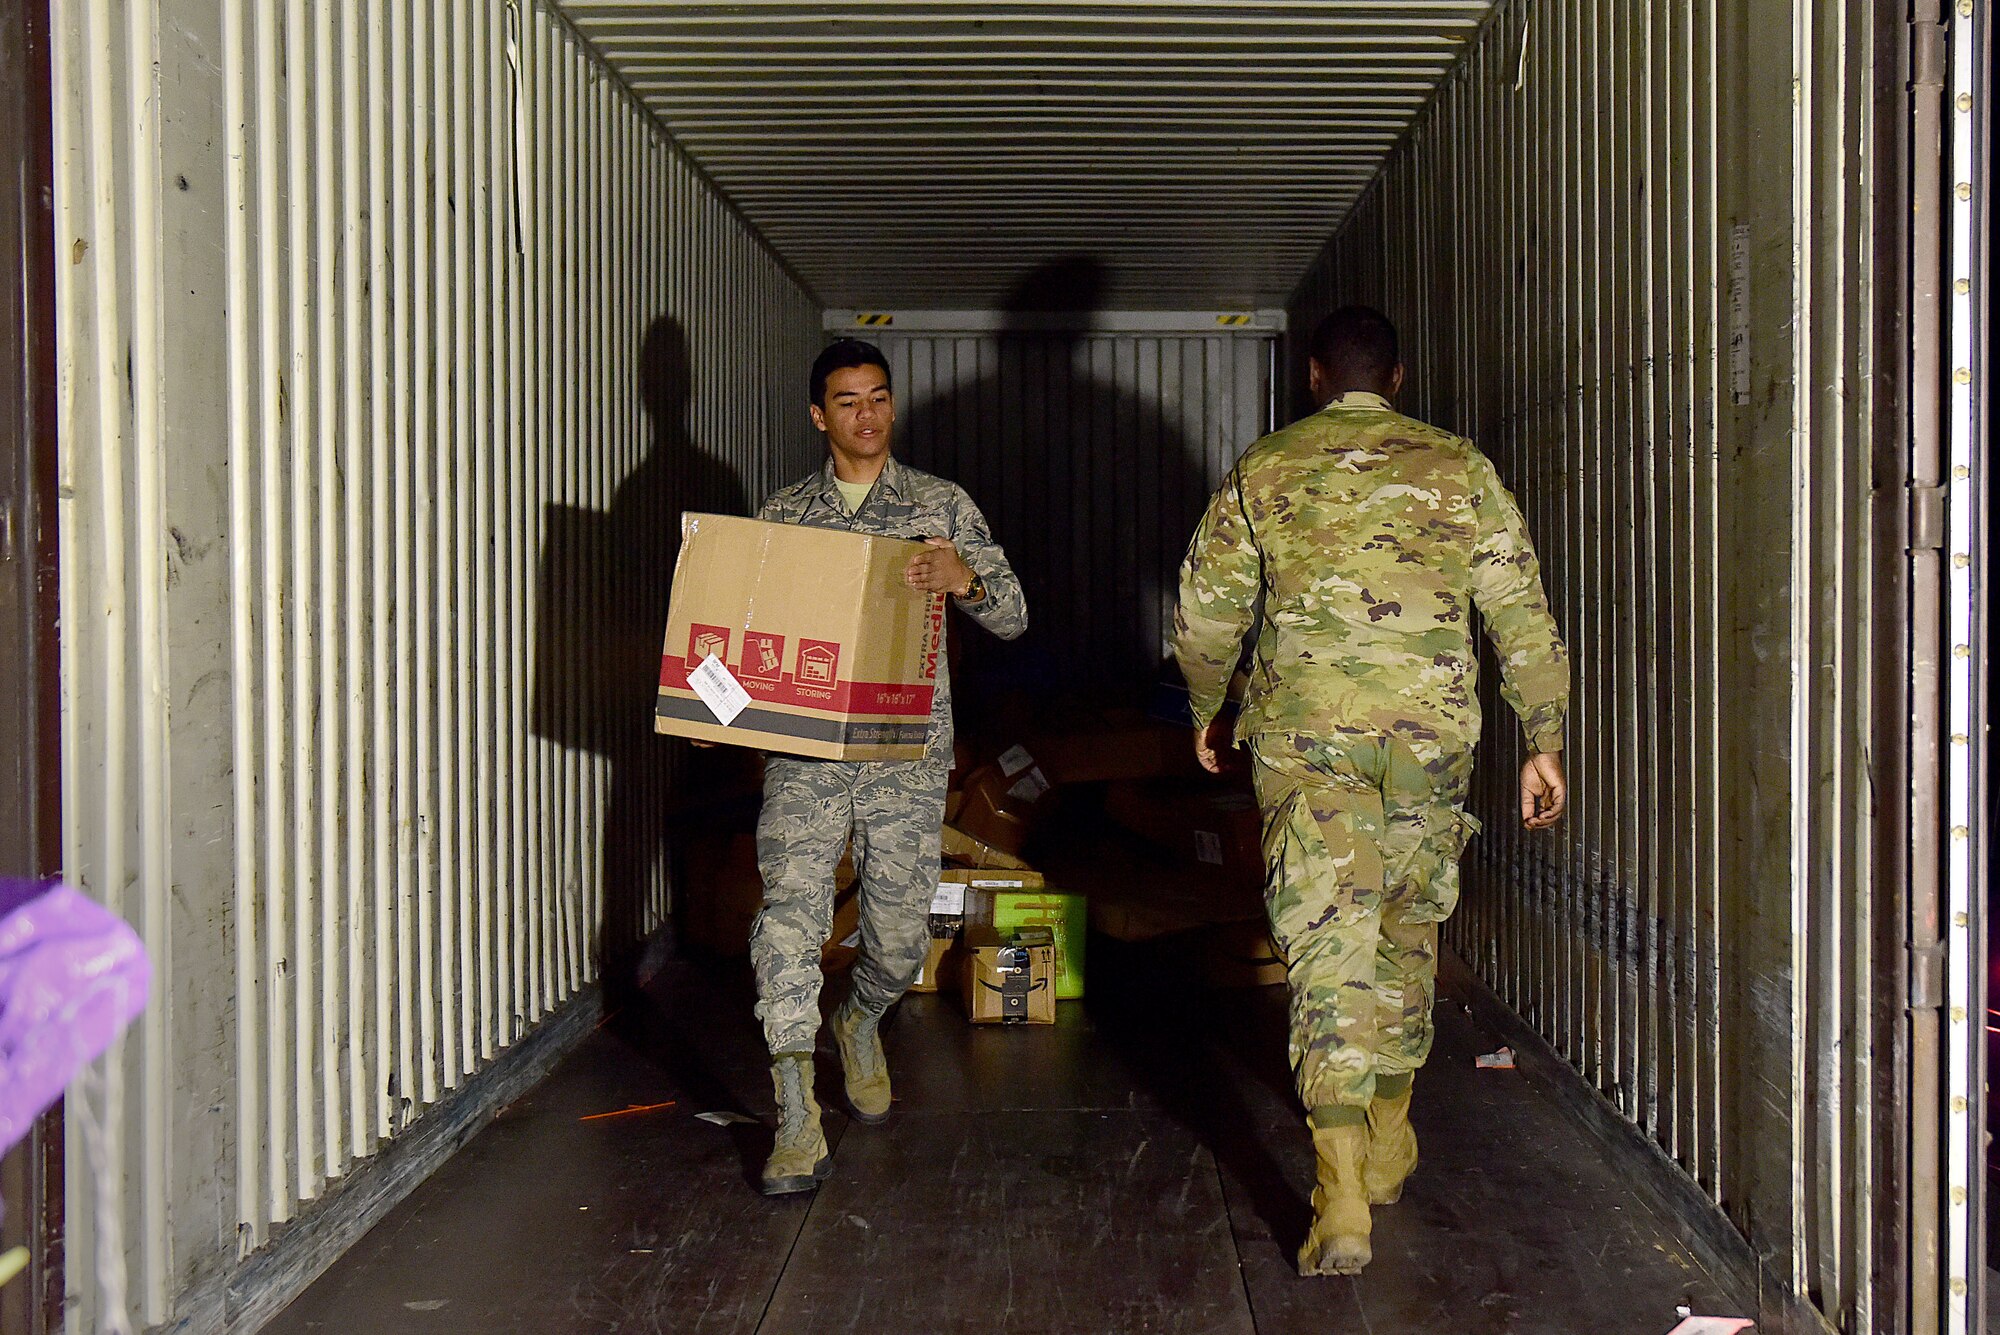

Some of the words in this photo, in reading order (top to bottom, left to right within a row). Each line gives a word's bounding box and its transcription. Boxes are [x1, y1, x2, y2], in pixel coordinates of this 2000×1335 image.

[918, 633, 928, 679] EXTRA
[742, 680, 775, 692] MOVING
[796, 687, 831, 701] STORING
